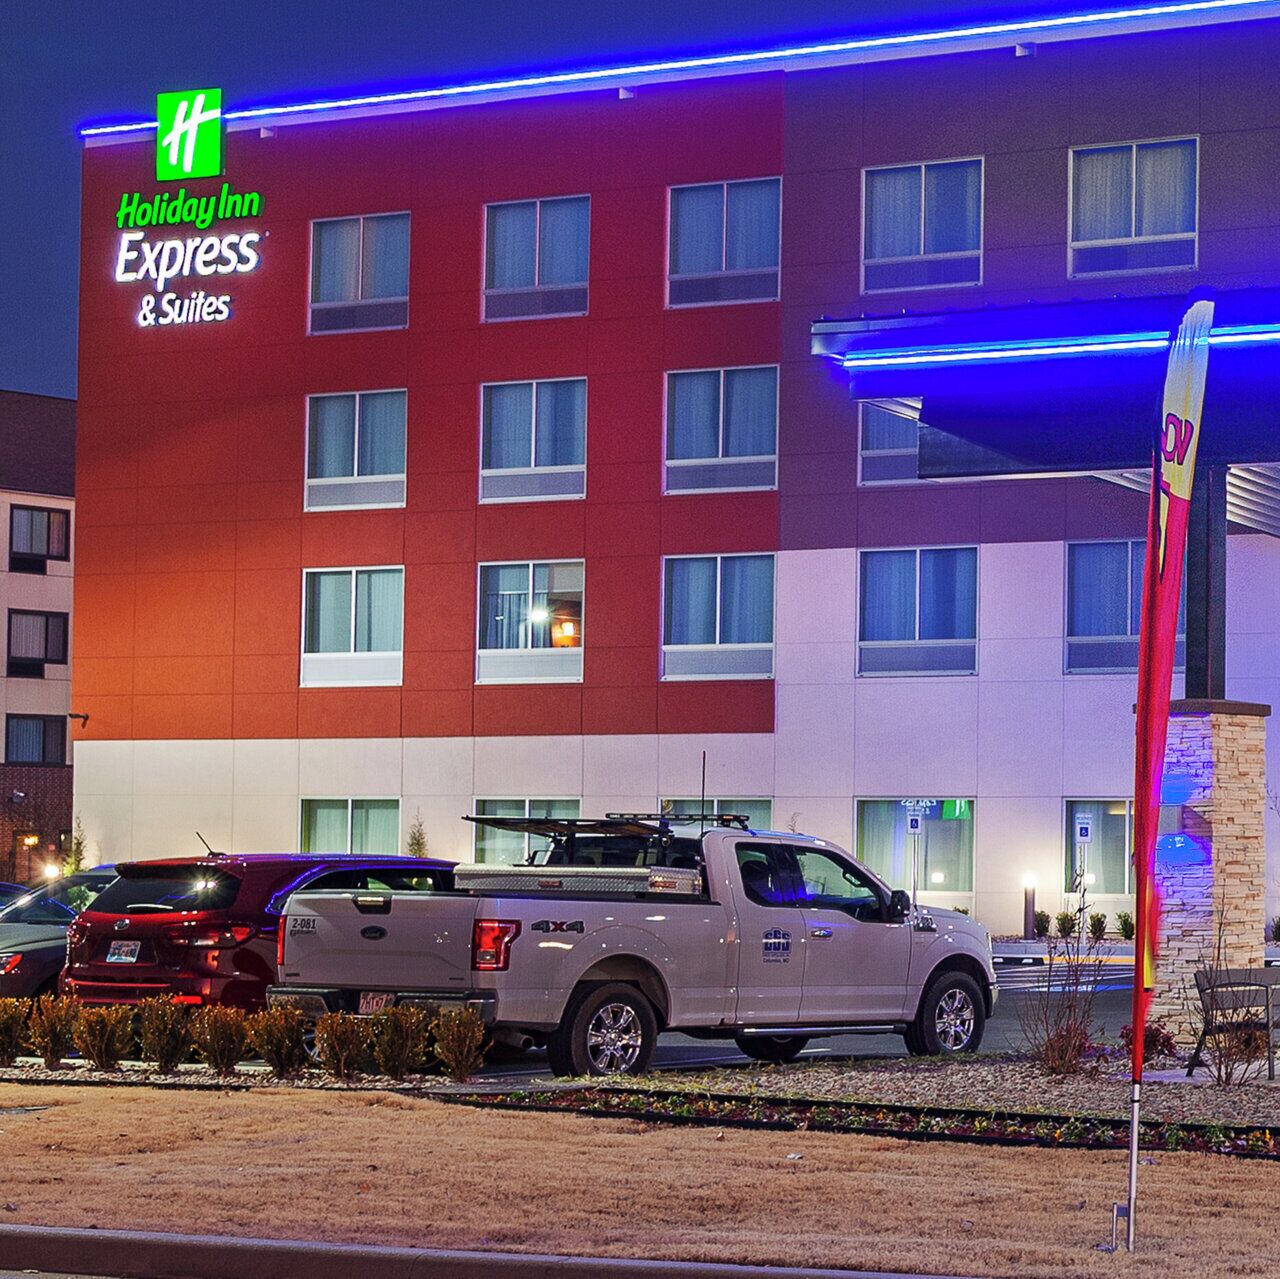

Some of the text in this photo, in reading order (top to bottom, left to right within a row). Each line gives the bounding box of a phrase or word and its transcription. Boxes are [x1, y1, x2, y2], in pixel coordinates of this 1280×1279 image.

[116, 183, 260, 229] Holiday Inn
[115, 230, 260, 292] Express
[137, 291, 231, 327] & Suites
[291, 918, 316, 930] 2-081
